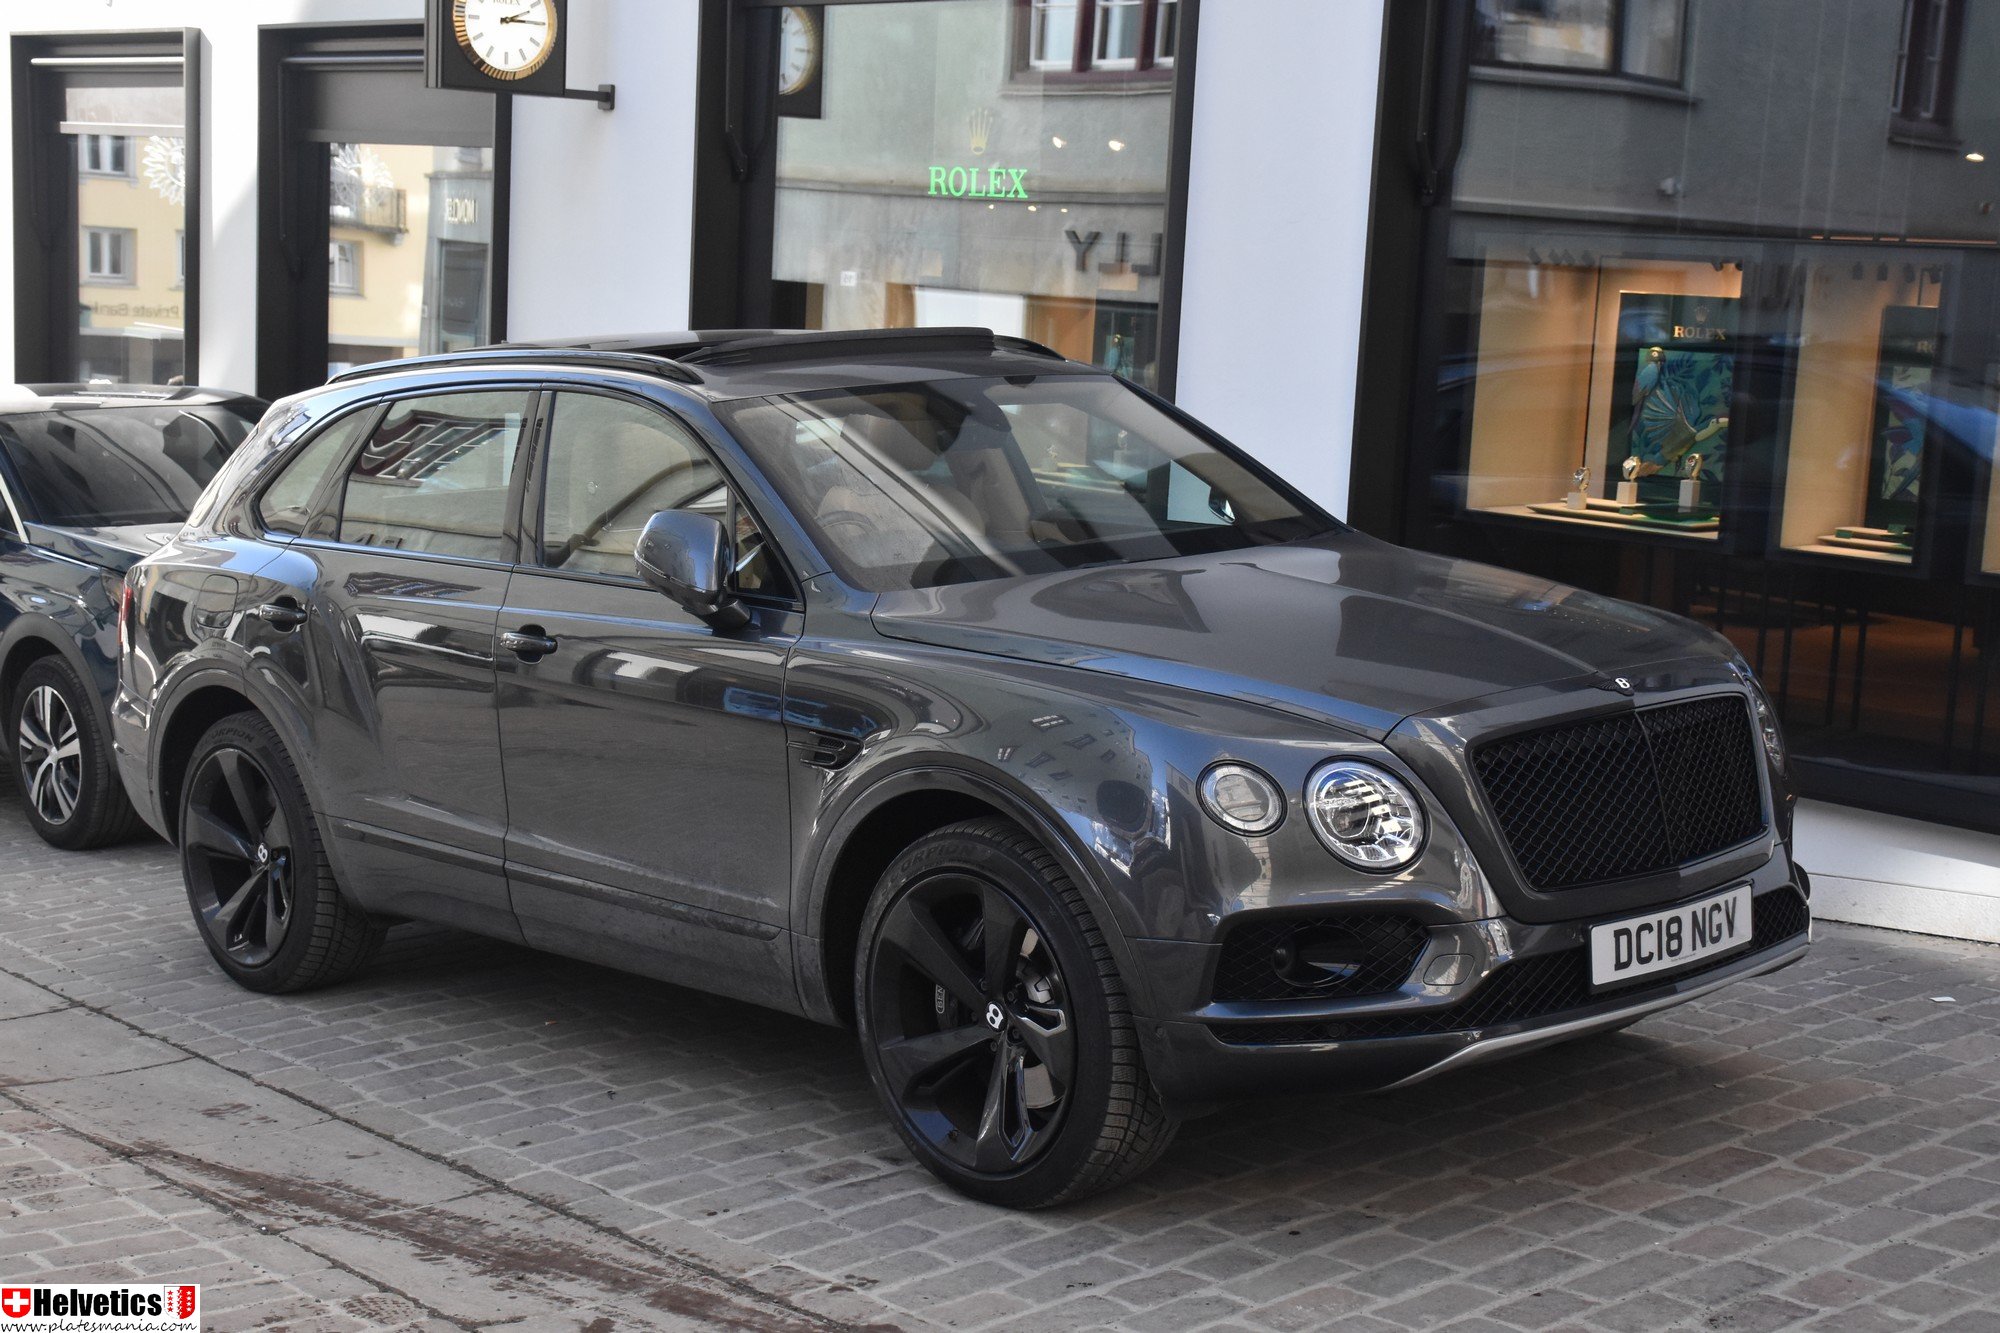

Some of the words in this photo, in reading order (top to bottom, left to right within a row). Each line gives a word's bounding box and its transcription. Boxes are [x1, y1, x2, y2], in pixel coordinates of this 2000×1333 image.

[927, 165, 1029, 199] ROLEX
[1673, 325, 1726, 340] ROLEX
[1613, 915, 1683, 971] DC18
[1691, 896, 1737, 951] NGV
